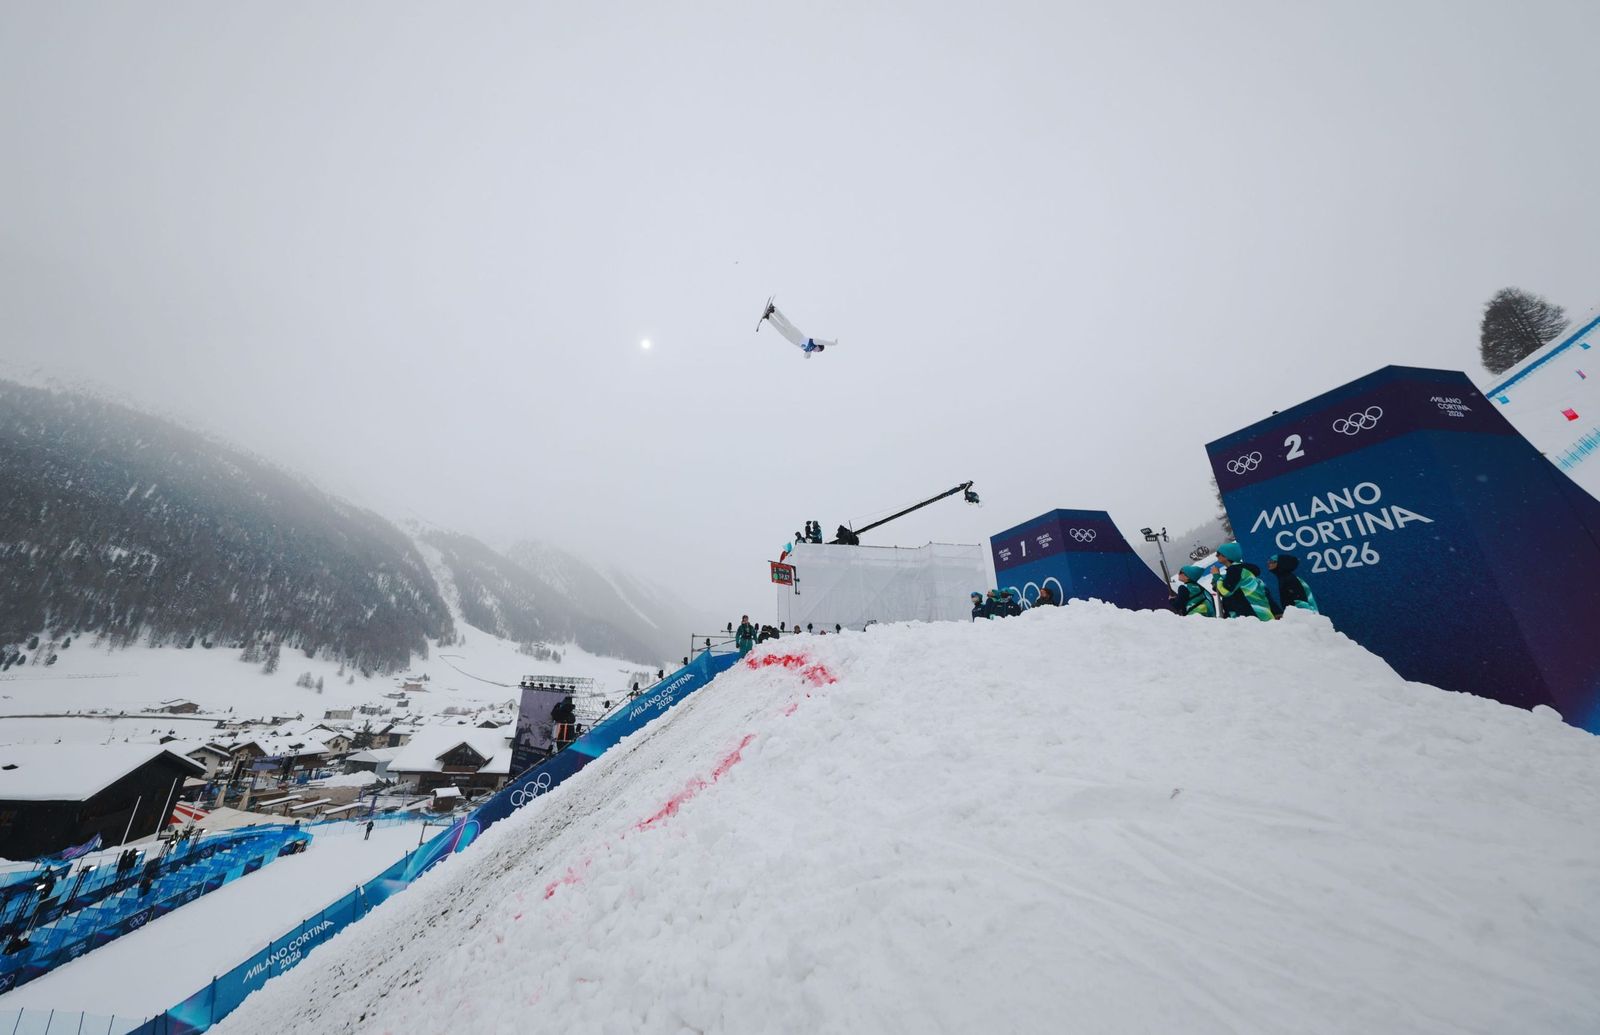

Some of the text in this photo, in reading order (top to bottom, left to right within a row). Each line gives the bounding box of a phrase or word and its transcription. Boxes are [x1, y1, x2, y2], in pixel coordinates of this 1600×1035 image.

[1430, 396, 1462, 404] MILANO
[1437, 403, 1472, 412] CORTINA
[1283, 434, 1305, 461] 2
[1250, 481, 1382, 535] MILANO
[1274, 504, 1435, 552] CORTINA
[1020, 540, 1026, 557] 1
[1306, 541, 1381, 574] 2026
[629, 673, 695, 721] MILANO CORTINA
[656, 695, 674, 710] 2026
[242, 920, 335, 984] MILANO CORTINA
[279, 949, 302, 970] 2026
